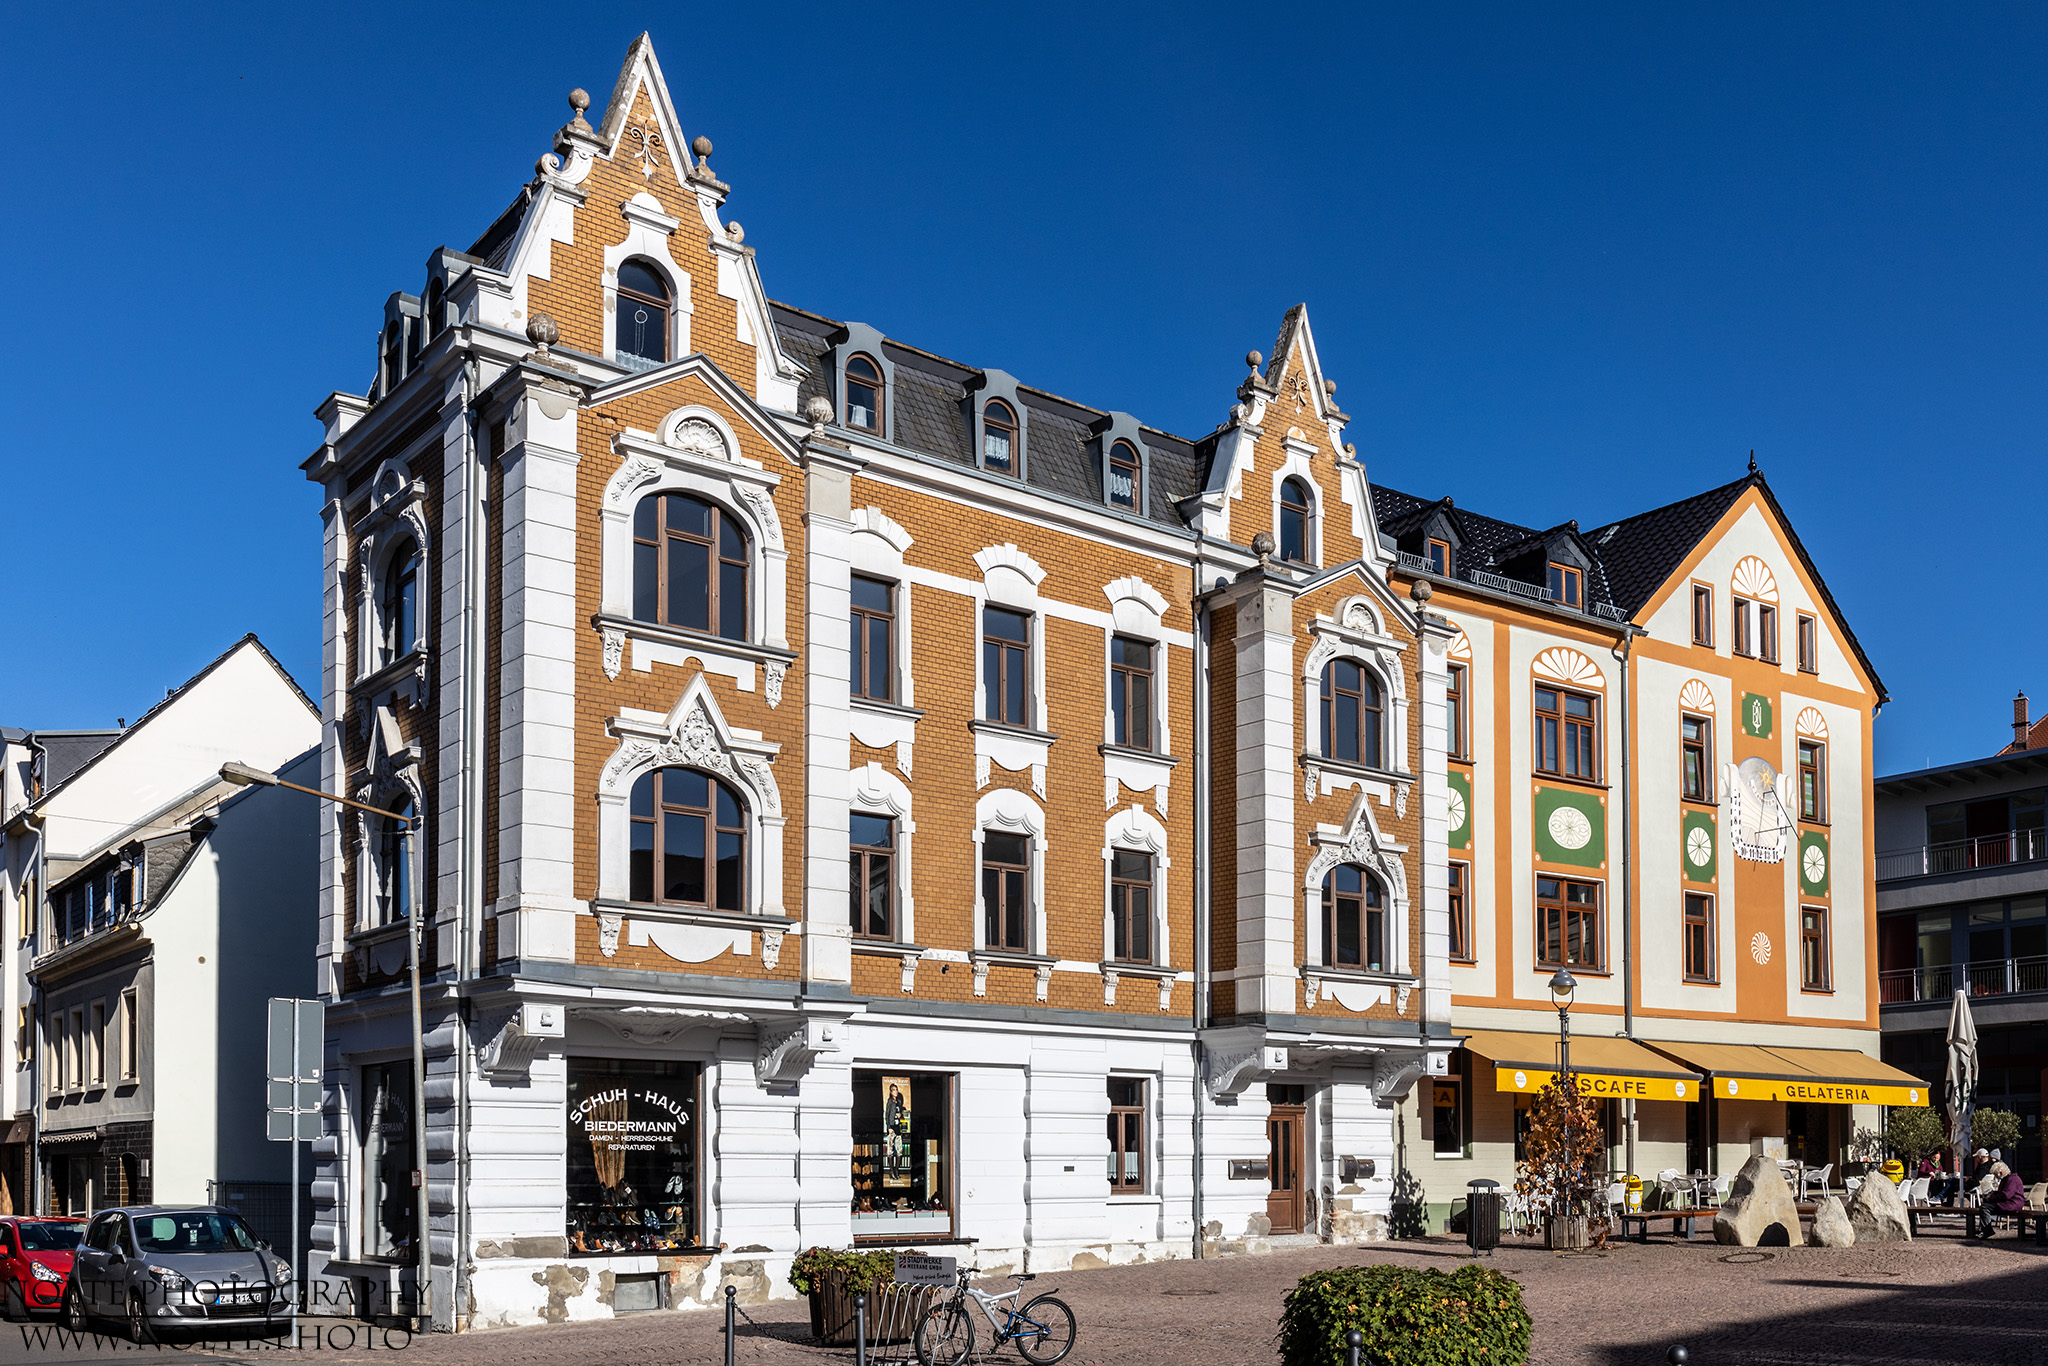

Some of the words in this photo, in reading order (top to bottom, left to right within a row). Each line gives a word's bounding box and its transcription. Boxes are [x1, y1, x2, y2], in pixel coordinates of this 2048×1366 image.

[1580, 1078, 1647, 1095] SCAFE
[1786, 1085, 1870, 1101] GELATERIA
[569, 1088, 628, 1125] SCHUH
[645, 1090, 690, 1126] HAUS
[584, 1121, 677, 1133] BIEDERMANN
[907, 1256, 942, 1264] STADTWERKE
